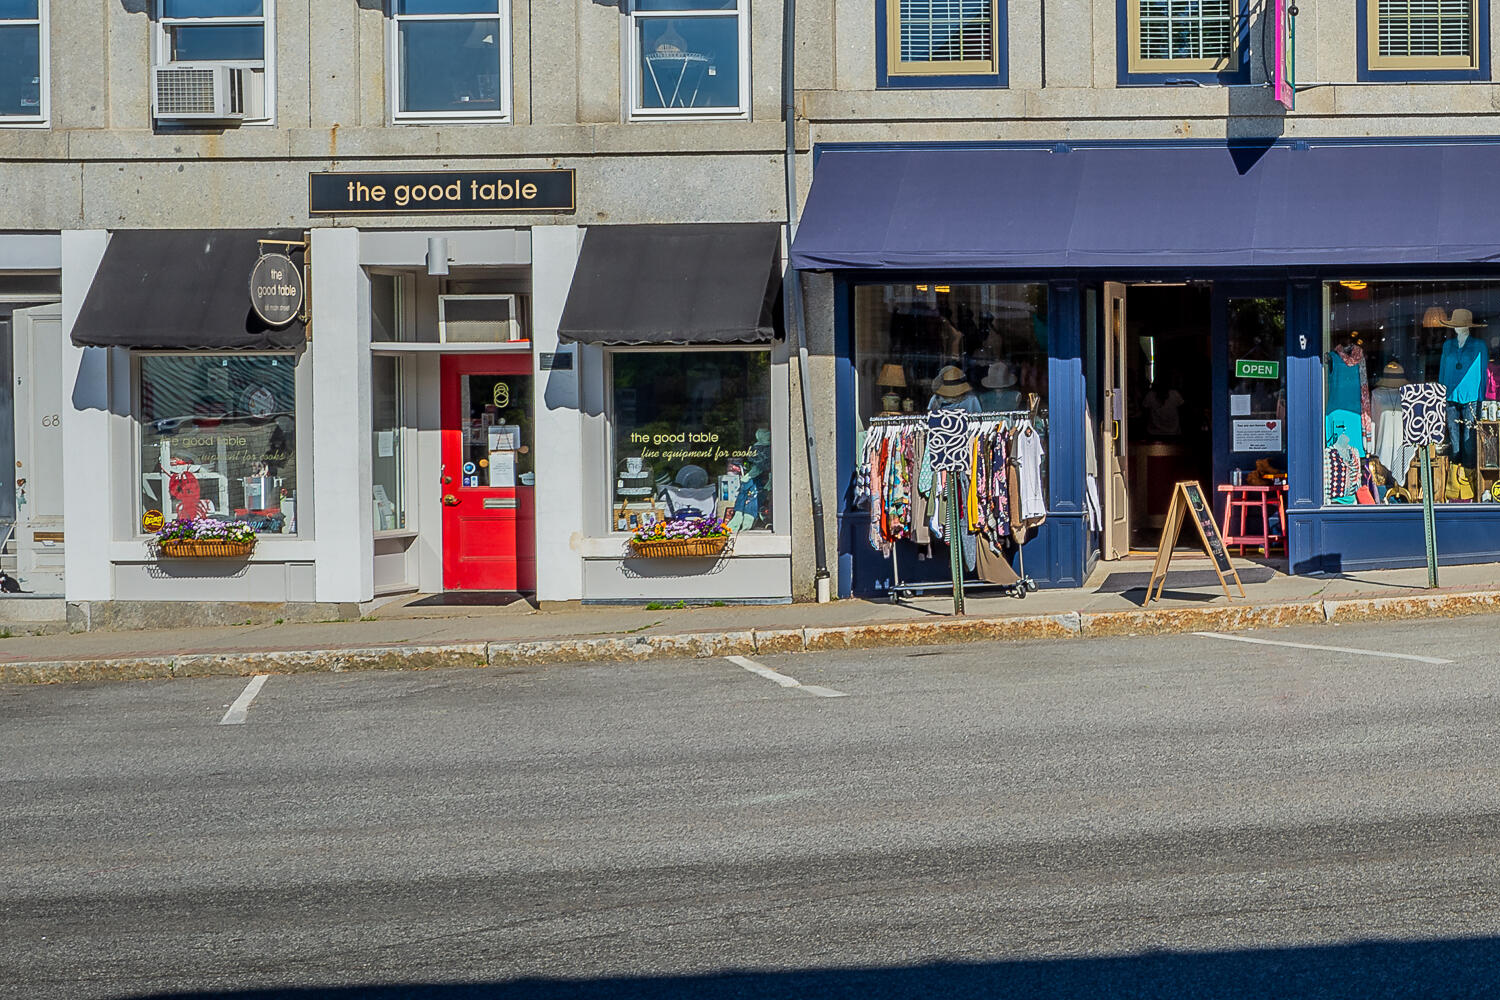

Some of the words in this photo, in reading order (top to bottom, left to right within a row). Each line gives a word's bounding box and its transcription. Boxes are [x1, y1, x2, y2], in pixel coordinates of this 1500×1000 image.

[347, 181, 386, 202] the
[394, 180, 461, 206] good
[470, 179, 538, 200] table
[270, 268, 283, 281] the
[257, 284, 277, 298] good
[278, 284, 296, 297] table
[1242, 364, 1273, 375] OPEN
[41, 414, 60, 427] 68
[182, 436, 213, 448] good
[630, 432, 650, 443] the
[653, 432, 685, 446] good
[688, 432, 719, 443] table
[640, 446, 660, 460] fine
[661, 447, 713, 462] equipment
[714, 446, 729, 461] for
[731, 446, 759, 458] cooks
